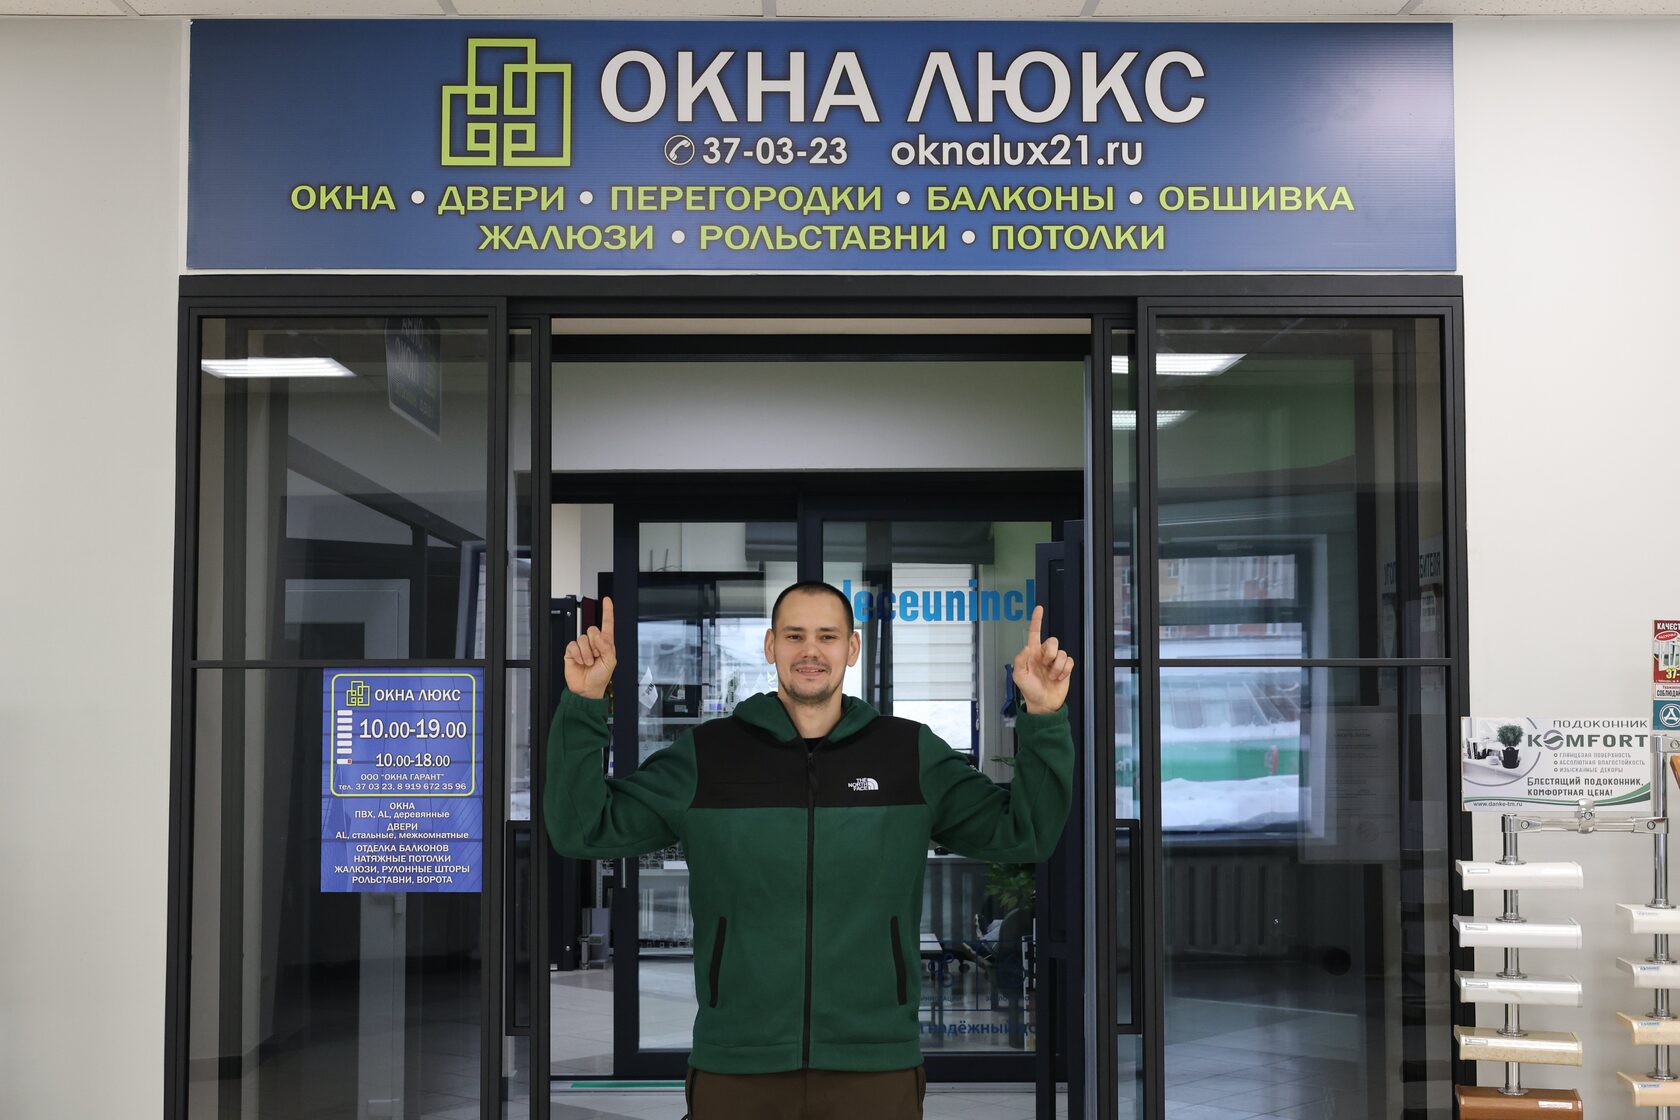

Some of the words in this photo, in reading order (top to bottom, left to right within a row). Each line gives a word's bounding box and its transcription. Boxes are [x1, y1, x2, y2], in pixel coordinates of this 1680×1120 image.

[600, 49, 880, 124] ОКНА
[907, 49, 1207, 124] ЛЮКС
[702, 136, 848, 166] 37-03-23
[891, 133, 1143, 168] oknalux21.ru
[290, 184, 396, 212] ОКНА
[437, 186, 566, 216] ДВЕРИ
[610, 186, 883, 216] ПЕРЕГОРОДКИ
[926, 186, 1116, 212] БАЛКОНЫ
[1158, 185, 1356, 212] ОБШИВКА
[478, 224, 655, 251] ЖАЛЮЗИ
[699, 224, 947, 251] РОЛЬСТАВНИ
[990, 224, 1166, 251] ПОТОЛКИ
[375, 690, 414, 701] ОКНА
[418, 689, 461, 701] ЛЮКС
[359, 719, 467, 739] 10.00-19.00
[1553, 720, 1648, 729] ПОДОКОННИК
[376, 754, 451, 767] 10.00-18.00
[1527, 788, 1584, 796] КОМФОРТНАЯ
[1587, 788, 1613, 797] ЦЕНА!
[387, 823, 418, 831] ДВЕРИ
[354, 855, 405, 863] НАТЯЖНЫЕ
[334, 866, 379, 874] ЖАЛЮЗИ,
[352, 876, 414, 884] РОЛЬСТАВНИ,
